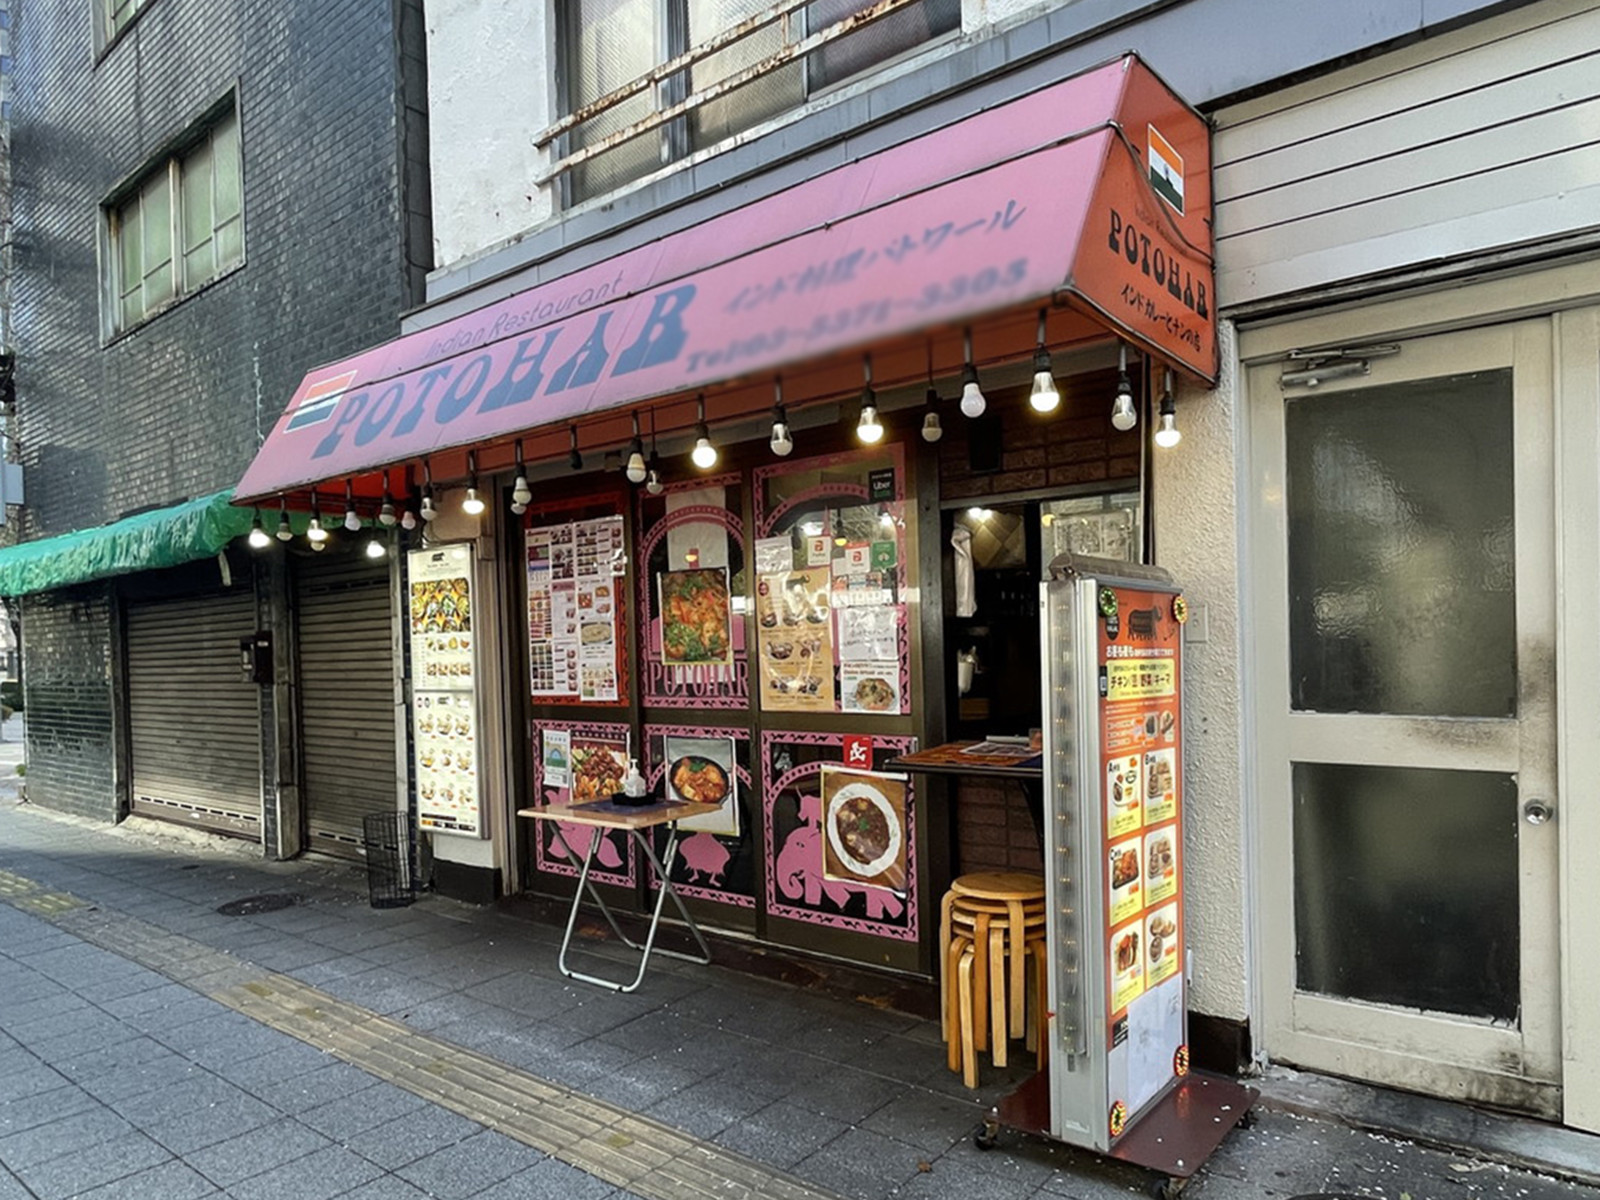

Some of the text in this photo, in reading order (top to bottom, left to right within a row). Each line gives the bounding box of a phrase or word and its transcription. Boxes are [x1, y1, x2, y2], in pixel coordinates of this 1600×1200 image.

[1108, 208, 1209, 320] POTOHAR
[425, 270, 624, 359] Indian Restaurant
[310, 283, 698, 459] POTOHAR
[649, 661, 749, 697] POTOHAR
